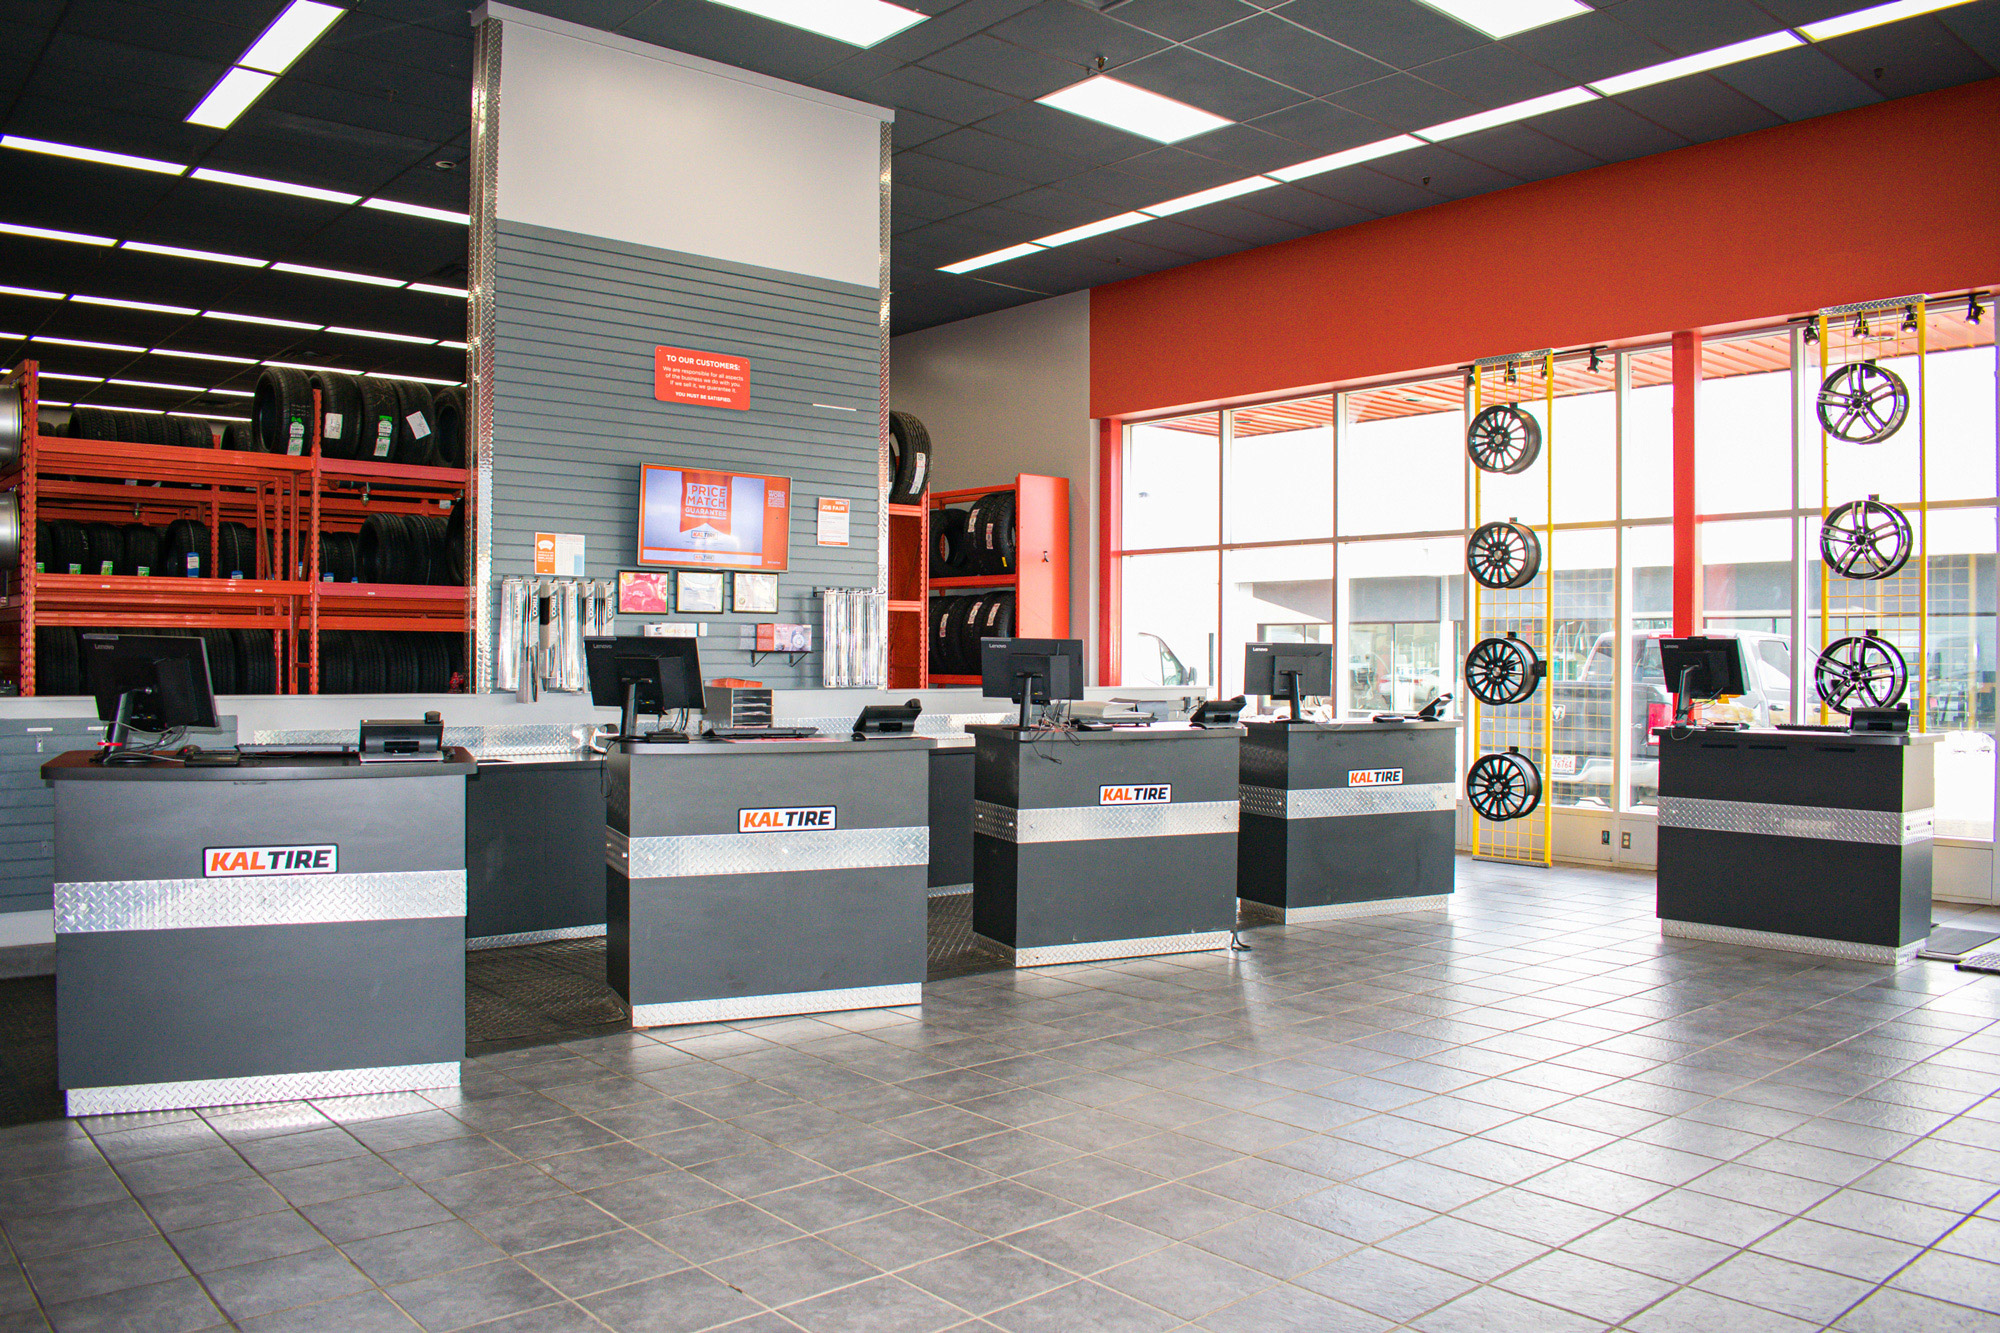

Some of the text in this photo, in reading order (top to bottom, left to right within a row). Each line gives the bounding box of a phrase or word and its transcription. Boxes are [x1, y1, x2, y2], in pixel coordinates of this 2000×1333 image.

[666, 354, 740, 370] TO OUR CUSTOMERS:
[682, 368, 710, 377] responsible
[691, 485, 726, 498] PRICE
[687, 496, 726, 508] MATCH
[685, 507, 727, 516] GUARANTEE
